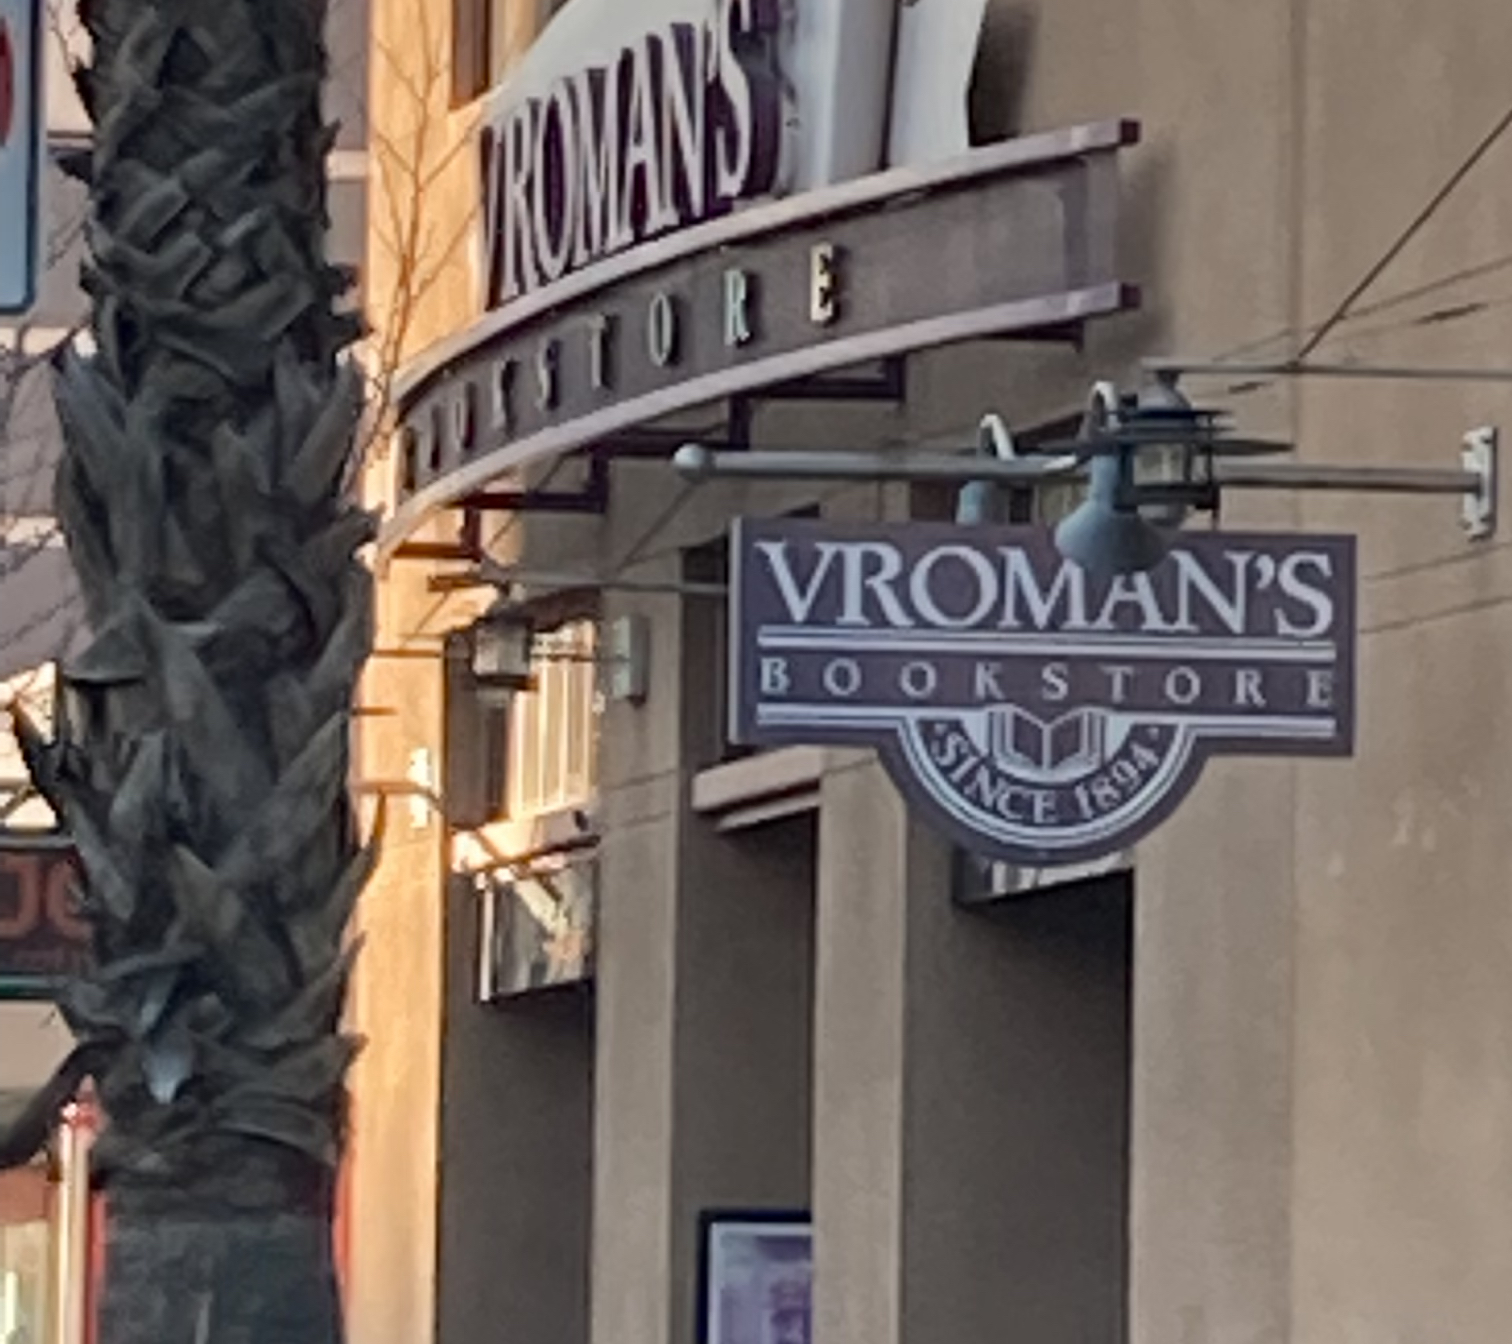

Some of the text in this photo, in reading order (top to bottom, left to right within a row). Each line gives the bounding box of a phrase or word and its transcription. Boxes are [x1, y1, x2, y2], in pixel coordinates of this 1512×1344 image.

[754, 541, 1334, 638] VROMAN'S
[759, 658, 1335, 708] BOOKSTORE
[930, 728, 1160, 824] SINCE 1894
